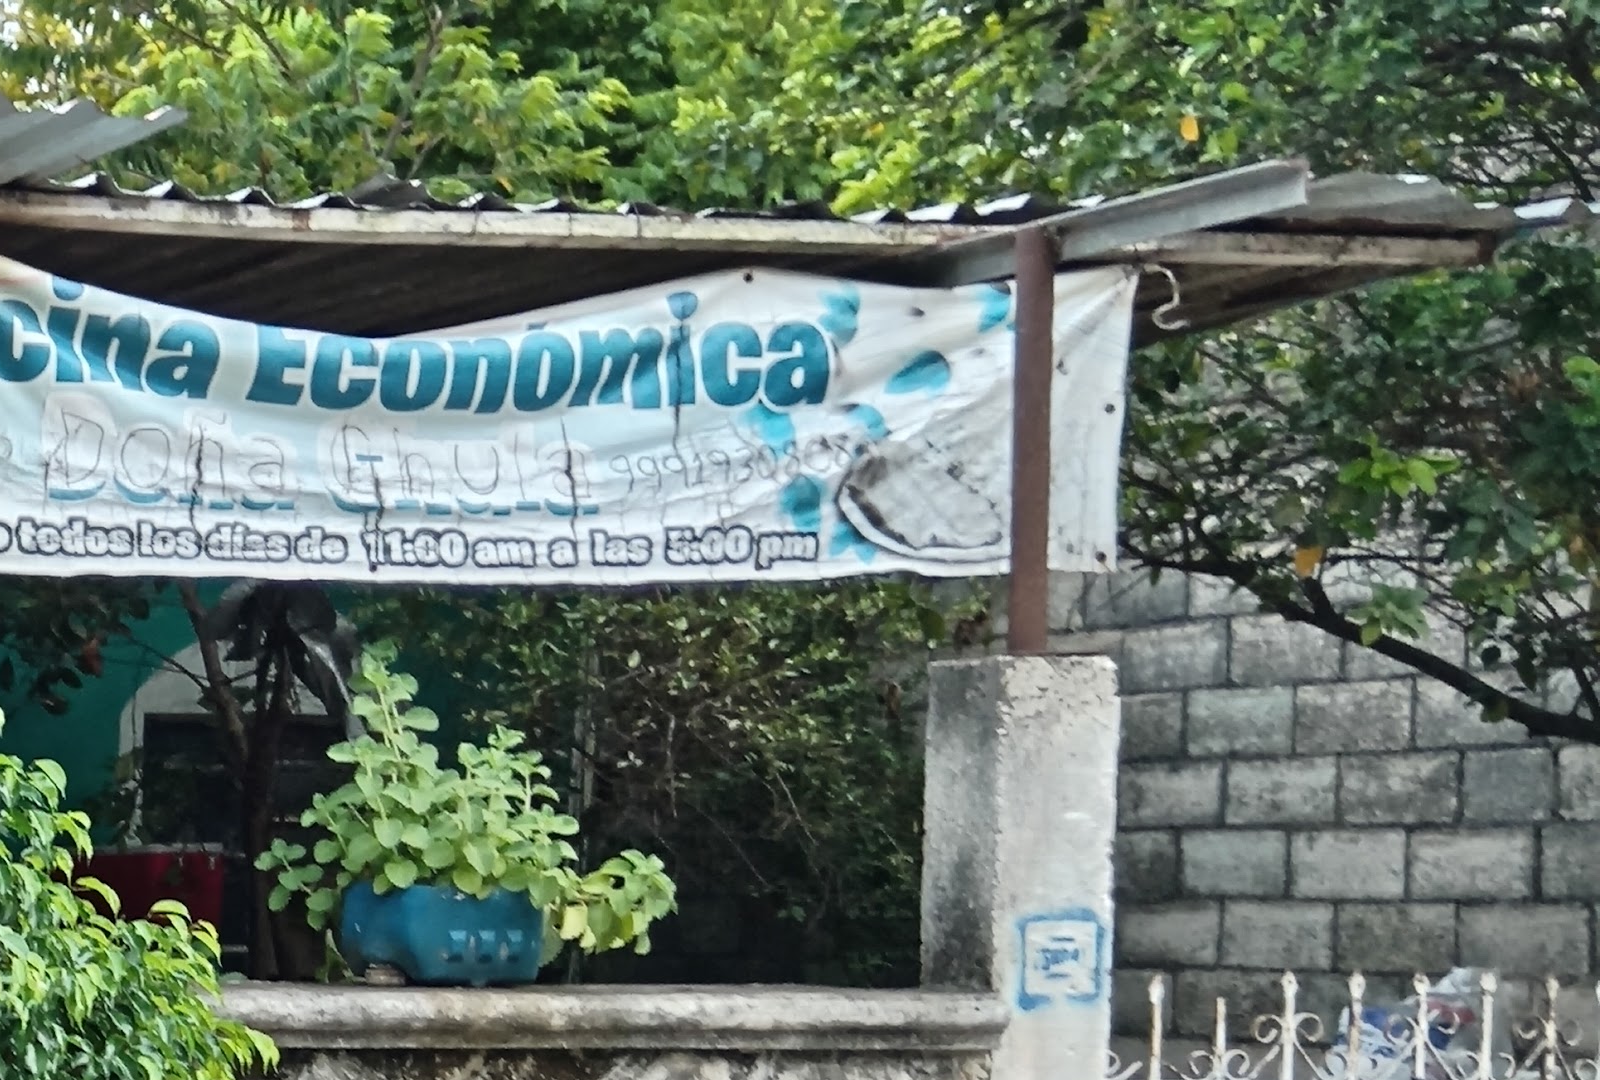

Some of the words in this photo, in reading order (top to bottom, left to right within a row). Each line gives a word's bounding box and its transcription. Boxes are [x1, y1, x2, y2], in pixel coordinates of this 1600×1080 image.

[244, 290, 832, 415] Económica
[14, 514, 134, 558] todos
[135, 518, 202, 560] los
[201, 520, 292, 563] días
[294, 524, 351, 565] de
[470, 534, 538, 569] am
[546, 536, 578, 569] a
[588, 528, 654, 569] las
[663, 524, 755, 567] 5:00
[754, 528, 820, 571] pm
